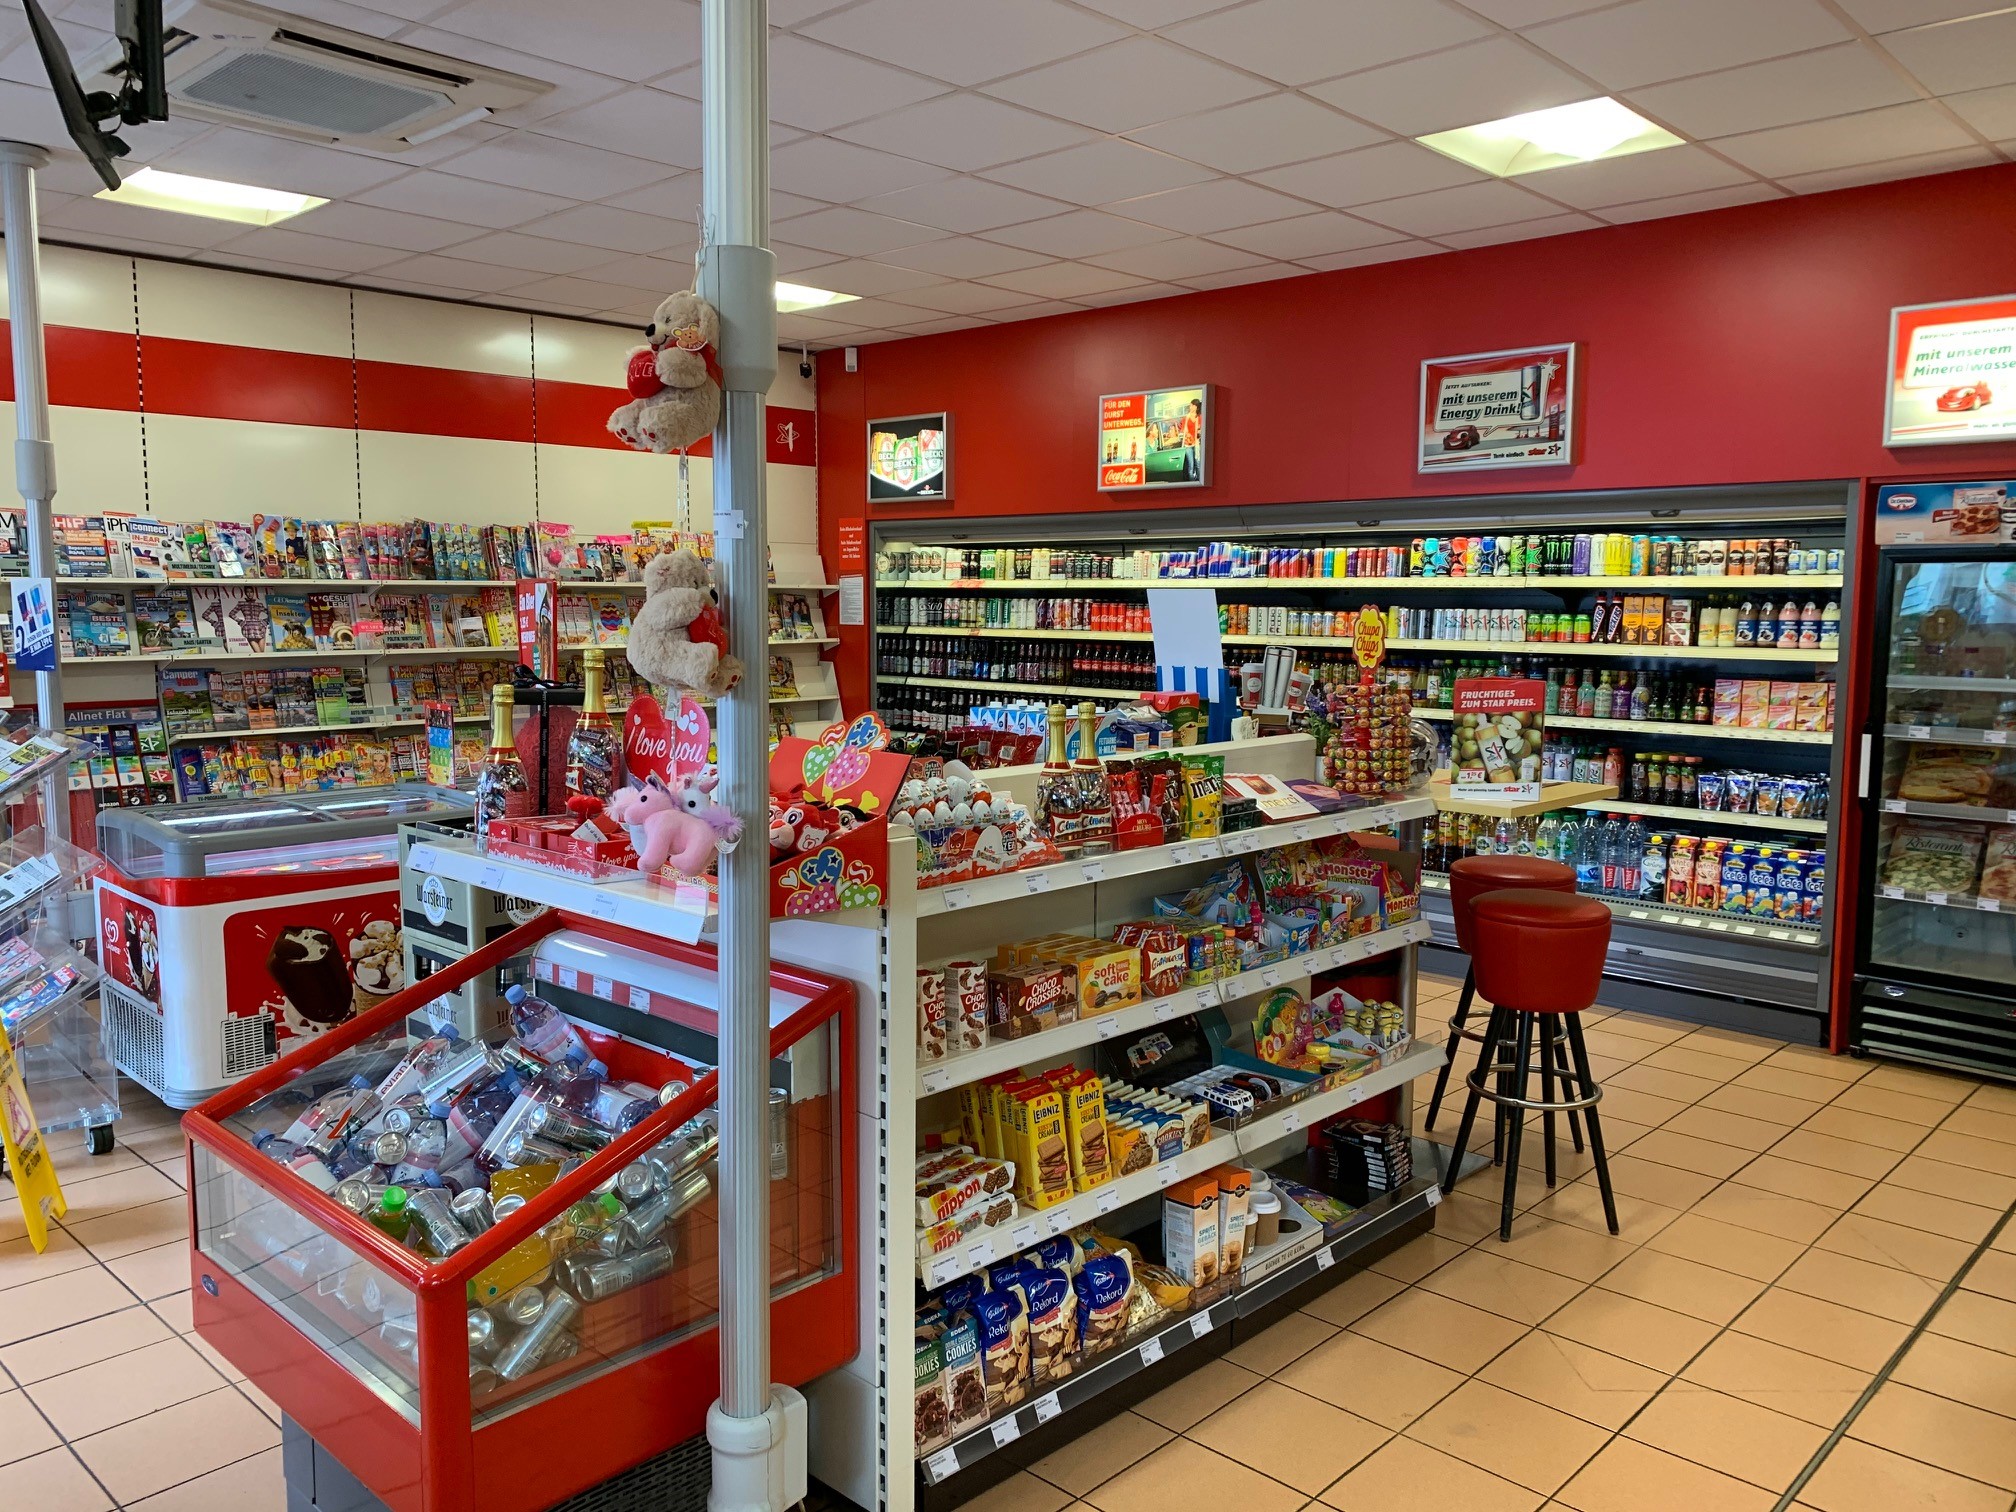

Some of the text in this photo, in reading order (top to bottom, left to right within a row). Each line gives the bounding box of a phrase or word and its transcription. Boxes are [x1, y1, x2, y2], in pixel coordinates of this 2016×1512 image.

[1916, 344, 2012, 362] mit unserem
[1913, 360, 2016, 377] Mineralwasse
[1104, 400, 1131, 409] FÜR DEN
[1442, 389, 1518, 406] mit unserem
[1104, 410, 1125, 419] DURST
[1440, 403, 1522, 422] Energy Drink!
[1103, 418, 1144, 428] UNTERWEGS.
[131, 523, 168, 535] connect
[132, 534, 160, 543] IN-EAR
[276, 609, 306, 617] Insekten
[1357, 621, 1380, 640] Chupa
[1356, 637, 1380, 656] Chups
[163, 670, 199, 680] Camper
[1461, 690, 1515, 700] FRUCHTIGES
[1461, 698, 1536, 708] ZUM STAR PREIS.
[68, 710, 126, 721] Allnet Flat
[633, 729, 665, 758] love
[666, 743, 704, 780] you
[1262, 794, 1299, 809] merci
[604, 856, 621, 867] love
[1324, 863, 1375, 879] Monster
[416, 884, 453, 911] Warsteiner
[1094, 963, 1116, 980] soft
[1103, 972, 1129, 986] cake
[1031, 978, 1057, 997] CHOCO
[1025, 985, 1061, 1011] CROSSIES
[380, 1064, 408, 1095] evian
[1076, 1089, 1100, 1108] LEIBNIZ
[1020, 1107, 1028, 1134] LEIBNIZ
[1034, 1104, 1060, 1123] LEIBNIZ
[1157, 1129, 1184, 1145] COOKIES
[936, 1178, 981, 1221] nippon
[1230, 1214, 1244, 1222] SPRITZ
[1199, 1224, 1216, 1236] SPRITZ
[1032, 1292, 1058, 1312] Rekord
[1096, 1285, 1122, 1303] Rekord
[924, 1312, 941, 1324] EDEKA
[951, 1324, 968, 1337] EDEKA
[946, 1338, 977, 1362] COOKIES
[915, 1356, 940, 1379] OOKIES
